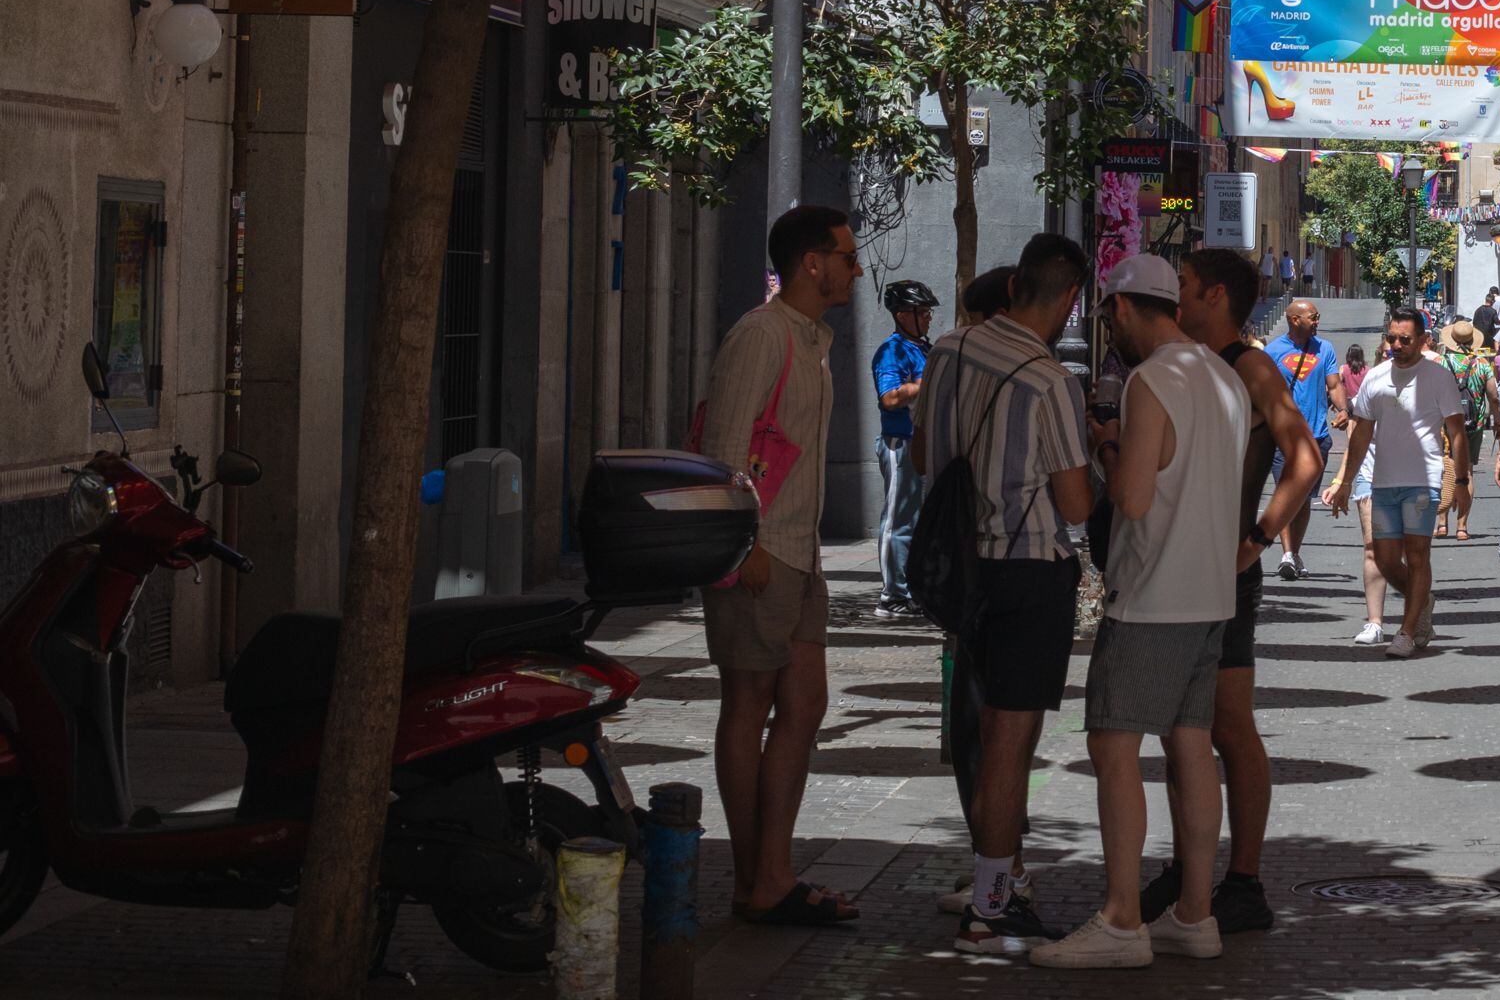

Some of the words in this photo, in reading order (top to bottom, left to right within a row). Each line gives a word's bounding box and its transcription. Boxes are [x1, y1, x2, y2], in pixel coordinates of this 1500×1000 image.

[1270, 11, 1311, 21] MADRID
[1369, 12, 1434, 28] madrid
[558, 52, 582, 100] &
[1436, 79, 1453, 87] CALLE
[1454, 79, 1475, 88] PELAYO
[1308, 87, 1335, 96] CHUMINA
[1311, 98, 1332, 107] POWER
[1106, 155, 1161, 165] SNEAKERS
[1136, 173, 1161, 184] ATM
